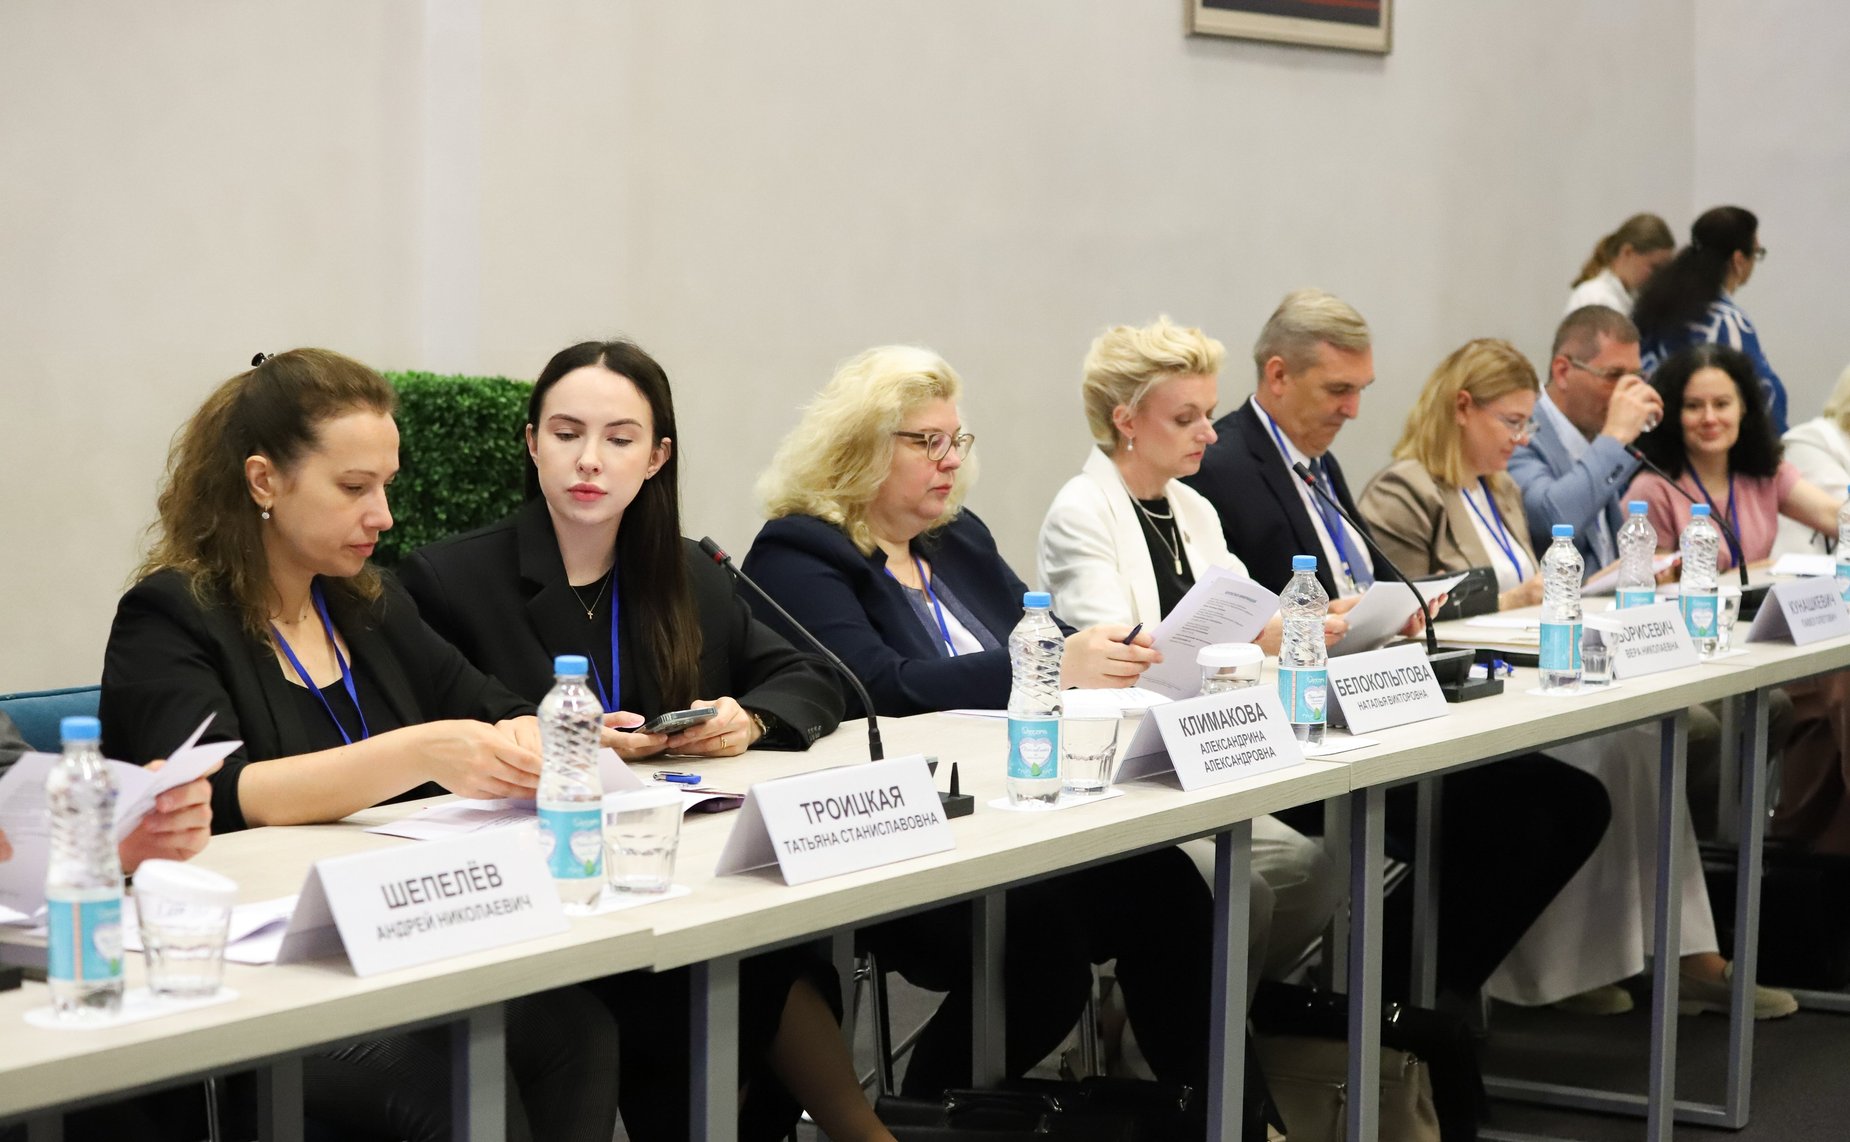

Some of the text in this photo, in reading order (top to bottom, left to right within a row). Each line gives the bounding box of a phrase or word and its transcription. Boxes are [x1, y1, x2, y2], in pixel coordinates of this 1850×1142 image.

[1335, 664, 1432, 697] БЕЛОКОПЫТОВА
[1357, 689, 1429, 711] НАТАЛЬЯ ВИКТОРОВНА
[1178, 702, 1268, 737] КЛИМАКОВА
[1200, 730, 1267, 755] АЛЕКСАНДРИНА
[1204, 746, 1276, 773] АЛЕКСАНДРОВНА
[800, 785, 905, 825] ТРОИЦКАЯ
[784, 812, 939, 855] ТАТЬЯНА СТАНИСЛАВОВНА
[381, 860, 503, 910] ШЕПЕЛЁВ
[376, 894, 533, 941] АНДРЕЙ НИКОЛАЕВИЧ
